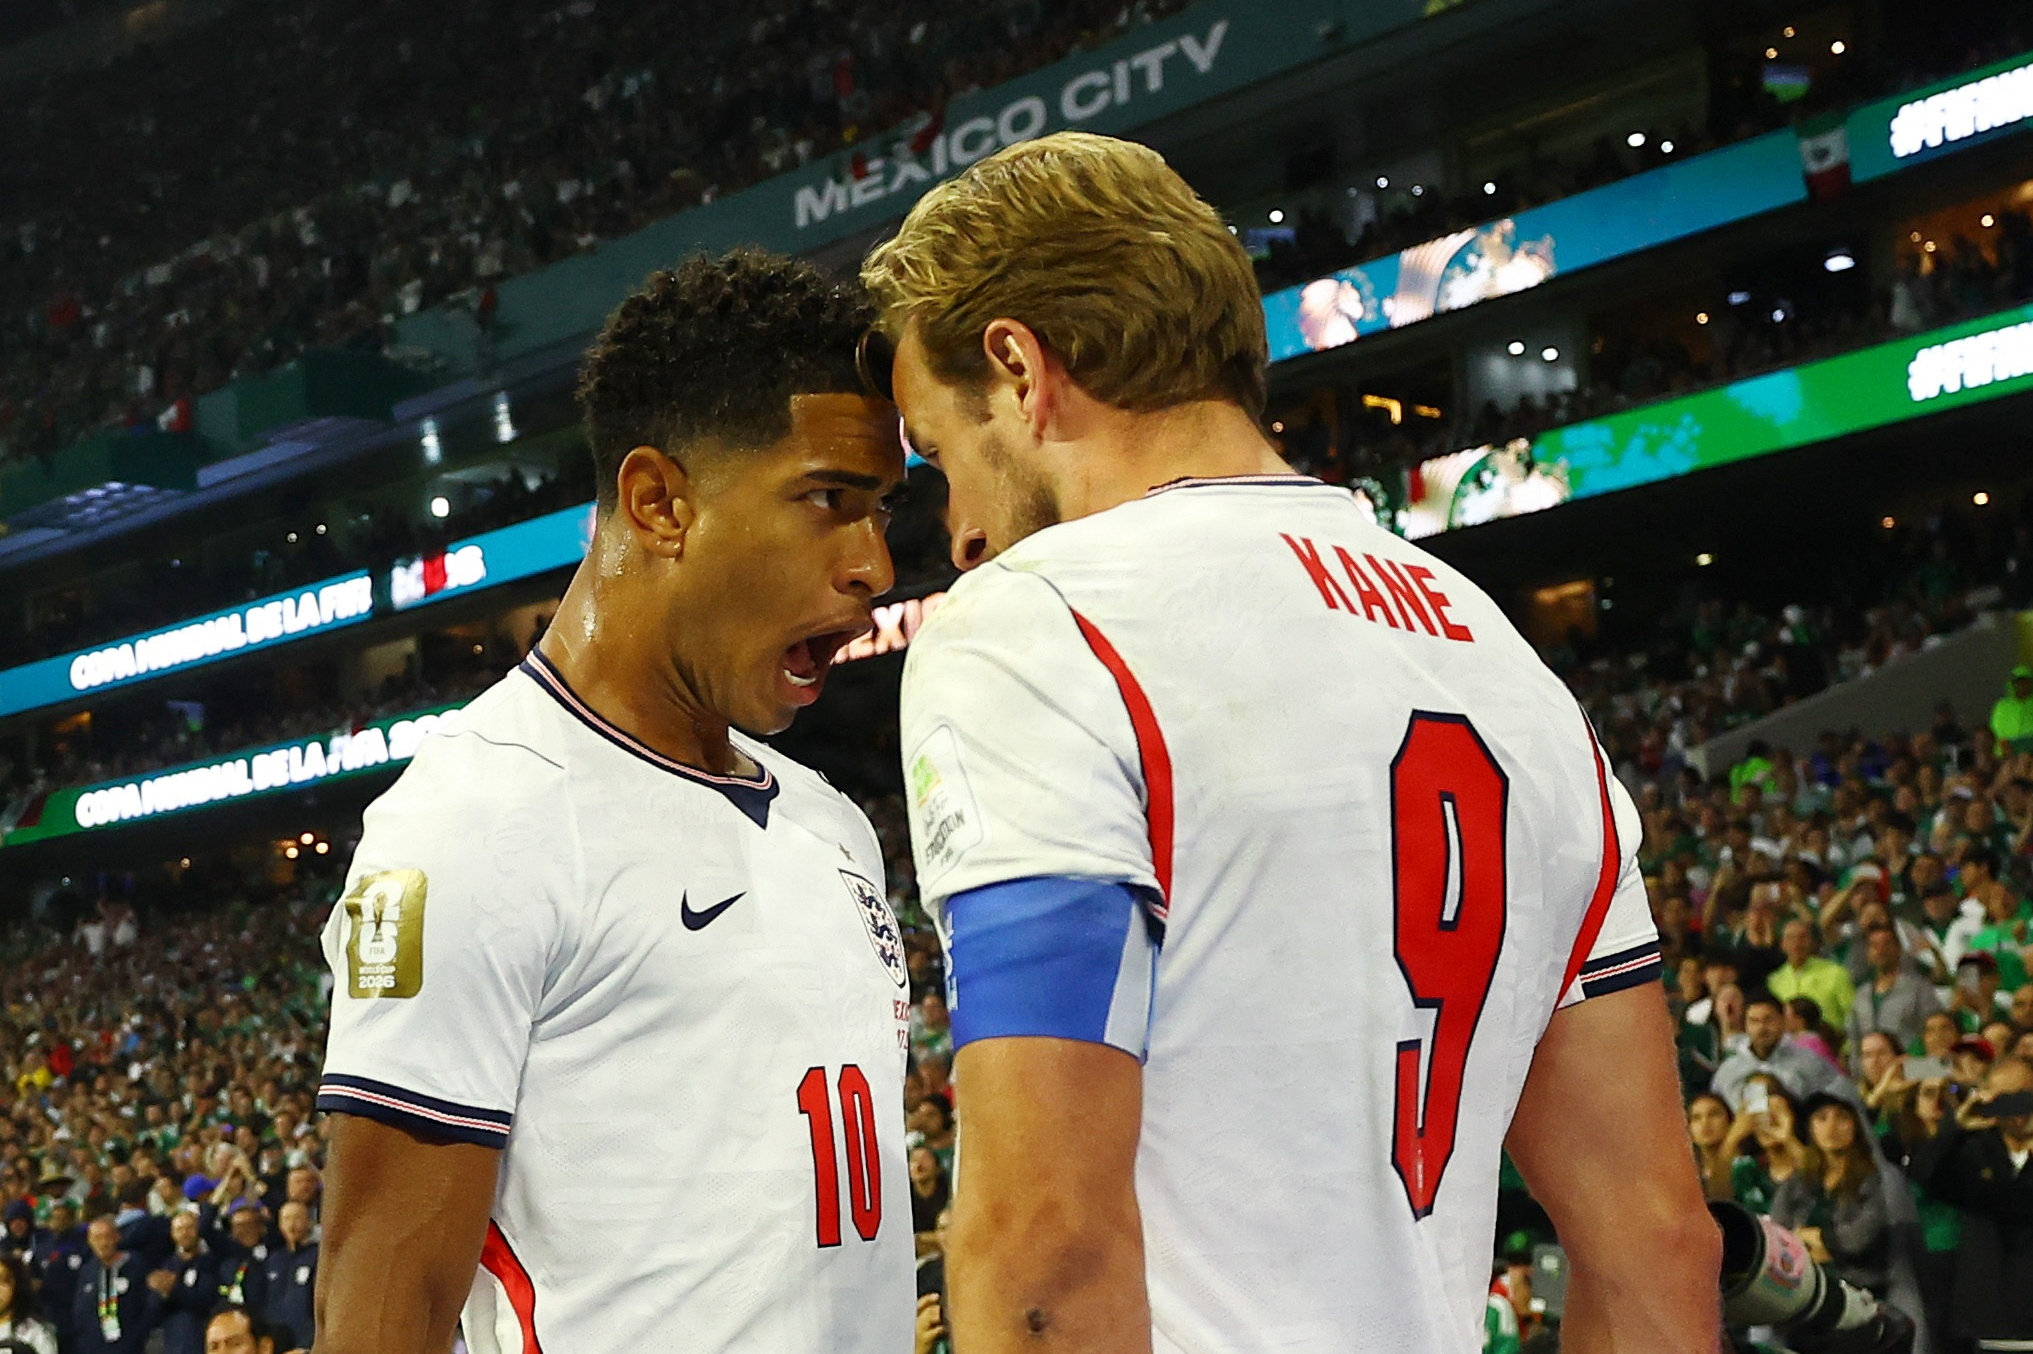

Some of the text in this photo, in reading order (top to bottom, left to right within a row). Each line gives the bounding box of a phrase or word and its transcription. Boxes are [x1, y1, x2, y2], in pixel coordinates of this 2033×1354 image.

[794, 20, 1229, 228] MEXICO CITY
[283, 592, 321, 634] LA
[1279, 532, 1475, 643] KANE
[289, 741, 327, 782] LA
[1390, 709, 1509, 1222] 9
[797, 1064, 882, 1248] 10
